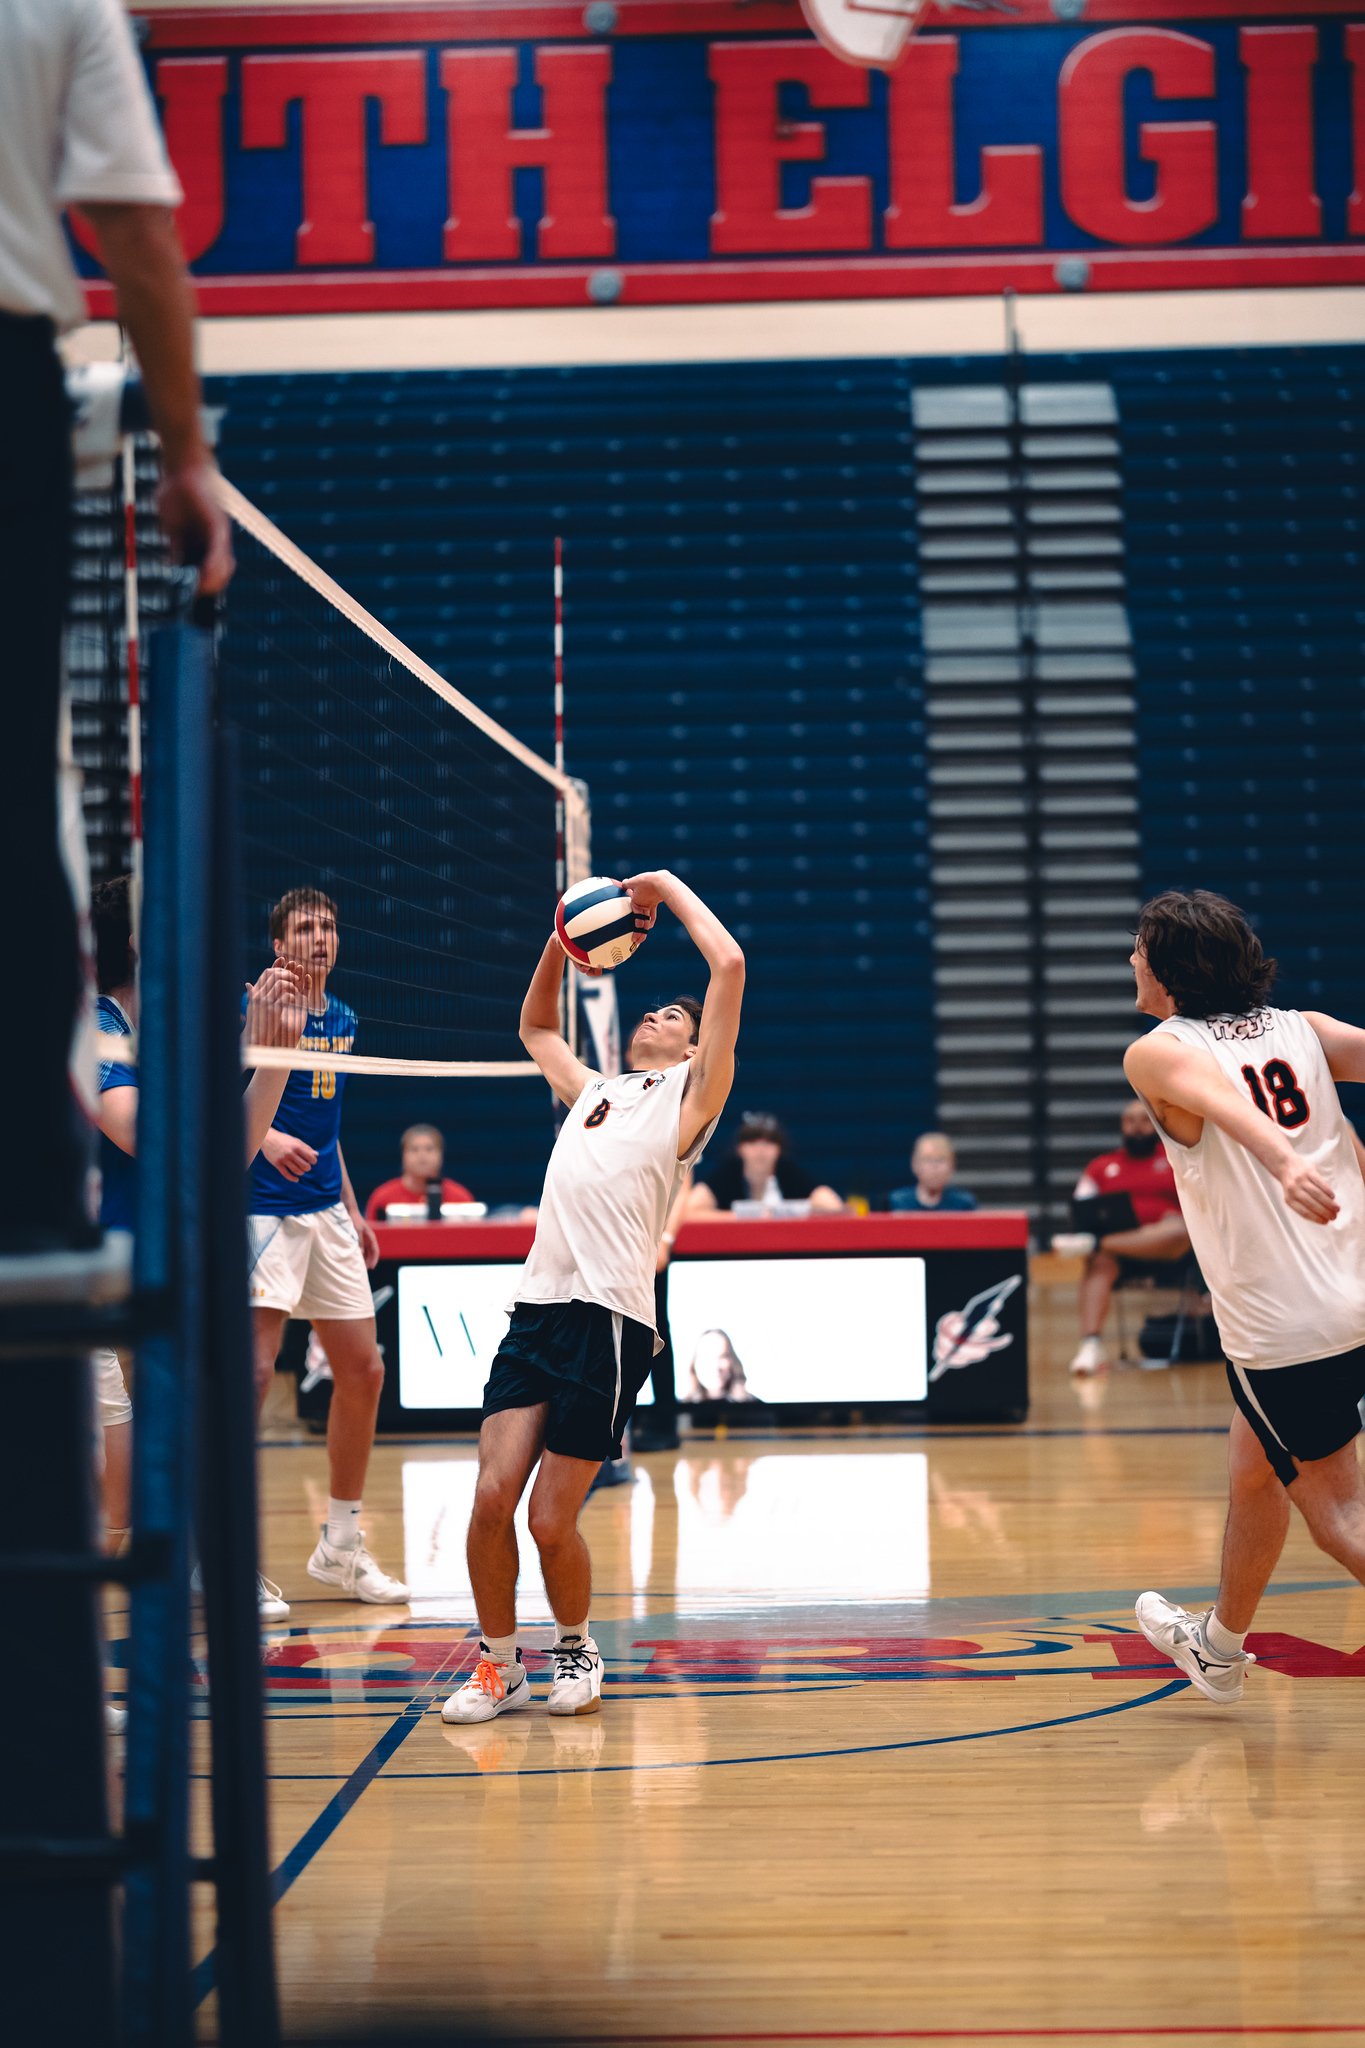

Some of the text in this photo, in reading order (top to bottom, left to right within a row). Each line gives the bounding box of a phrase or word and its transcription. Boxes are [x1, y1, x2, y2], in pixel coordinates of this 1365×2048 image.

[708, 26, 1365, 253] ELGI
[311, 1069, 336, 1099] 10
[1241, 1057, 1310, 1130] 18
[584, 1098, 611, 1130] 8
